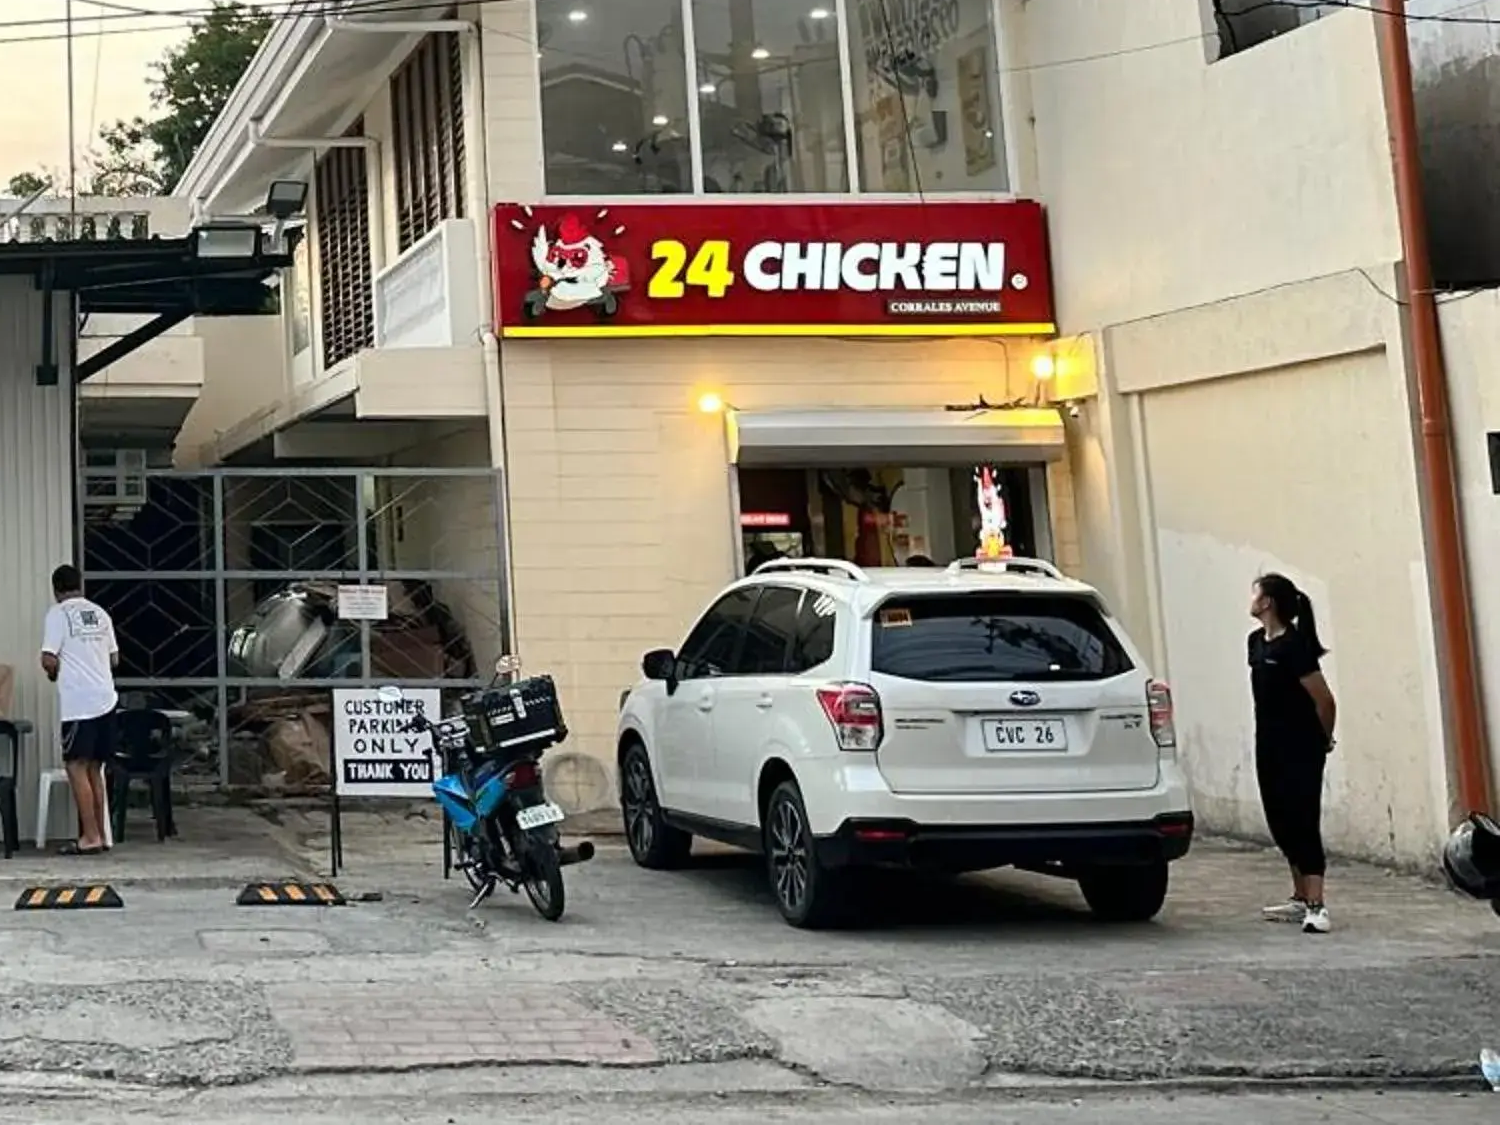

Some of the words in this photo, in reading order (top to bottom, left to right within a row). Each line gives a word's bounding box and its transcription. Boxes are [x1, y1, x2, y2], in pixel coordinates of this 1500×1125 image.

[648, 240, 735, 298] 24
[743, 240, 1005, 292] CHICKEN
[890, 301, 952, 312] CORRALES
[953, 301, 1001, 312] AVENUE
[344, 699, 425, 715] CUSTOMER
[995, 726, 1025, 744] CVC
[1035, 725, 1054, 744] 26
[353, 738, 419, 753] ONLY
[347, 762, 394, 779] THANK
[399, 762, 430, 779] YOU
